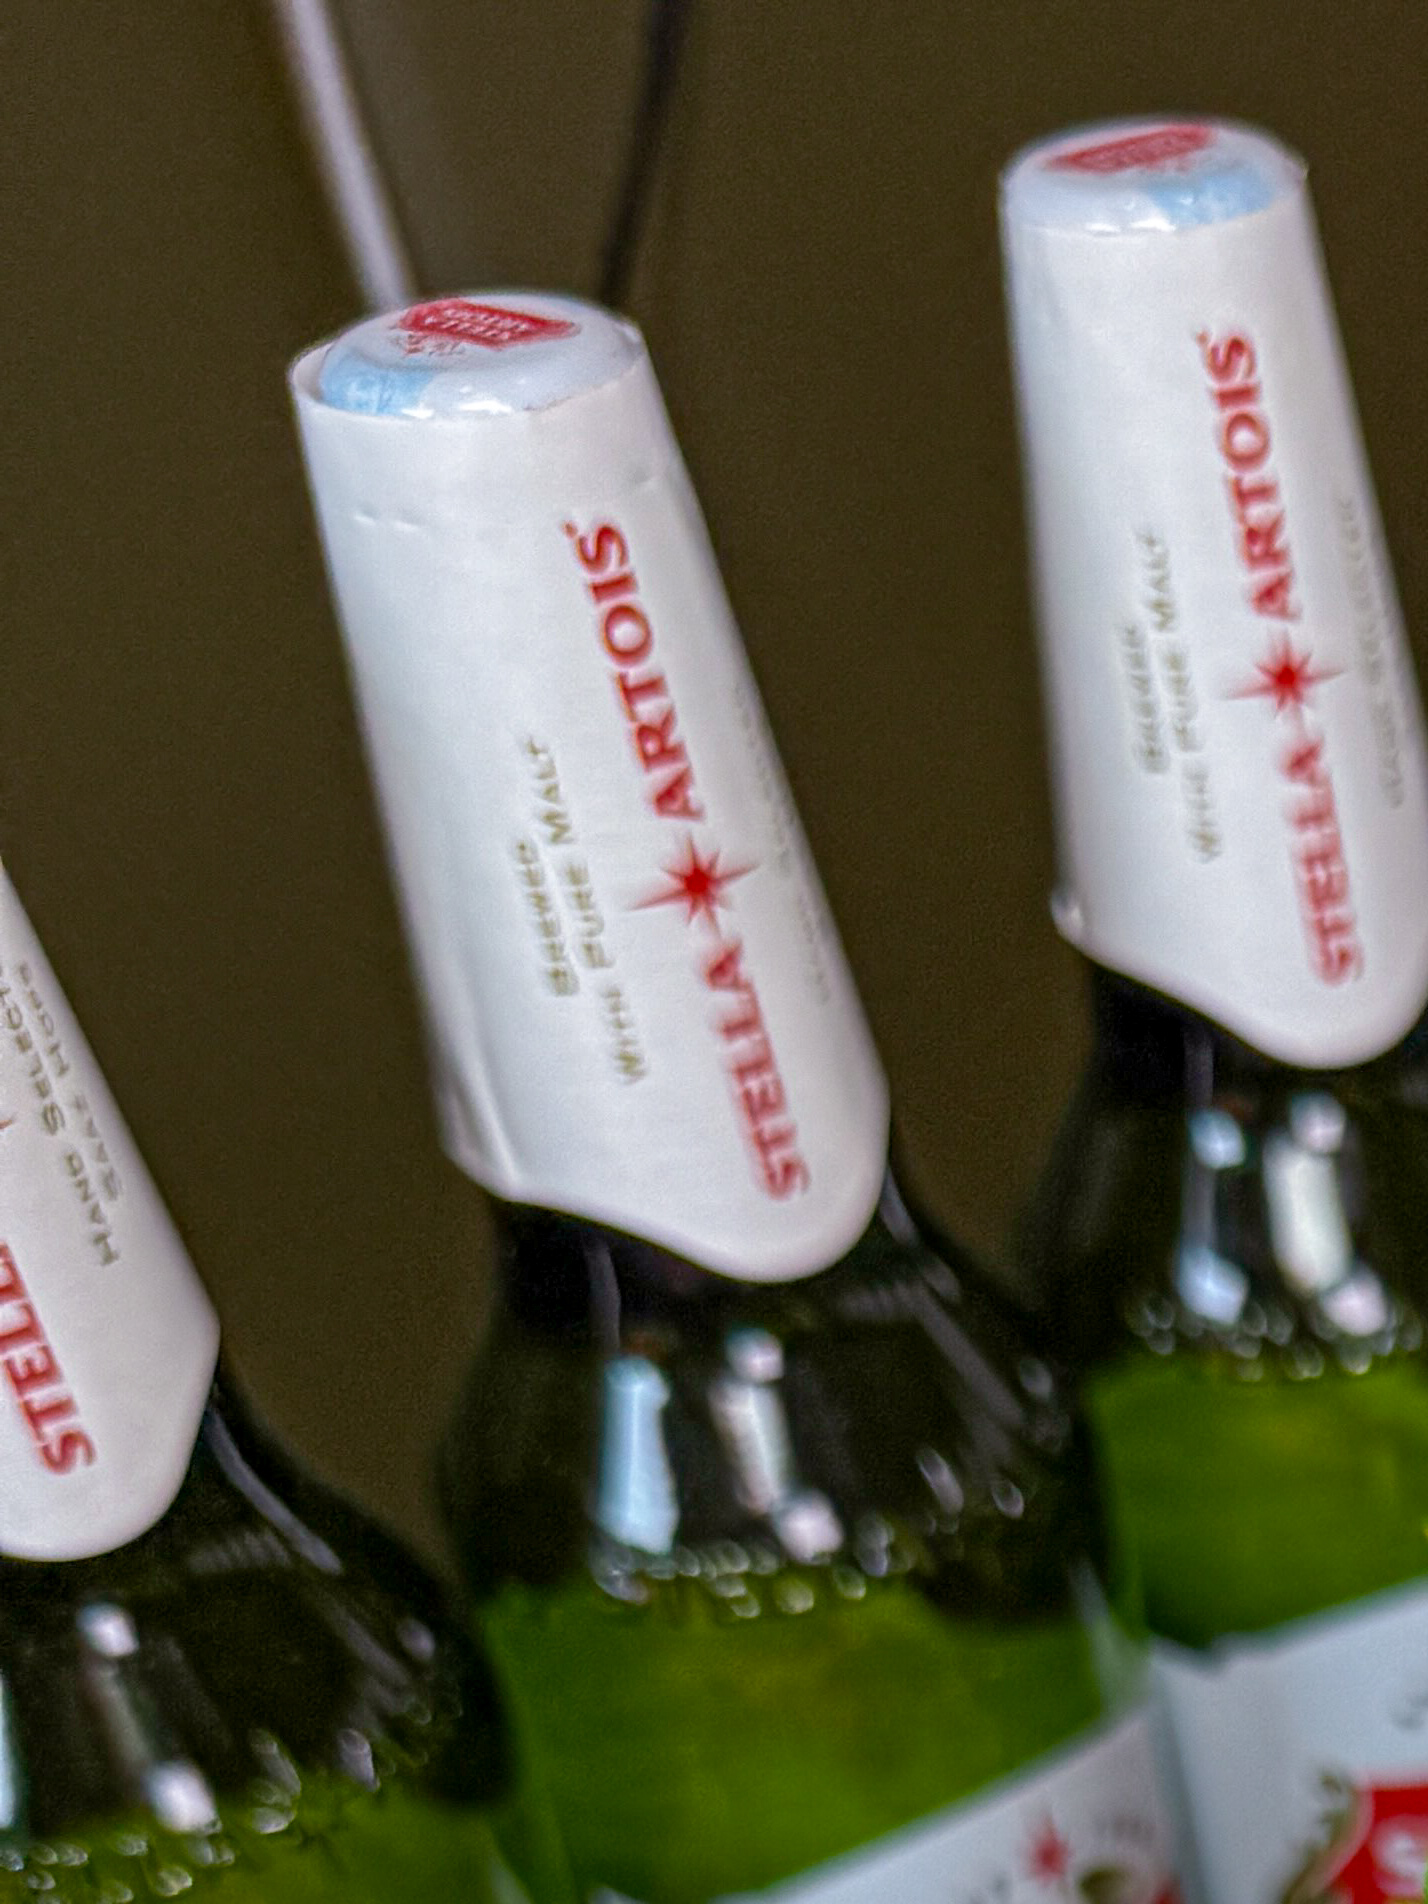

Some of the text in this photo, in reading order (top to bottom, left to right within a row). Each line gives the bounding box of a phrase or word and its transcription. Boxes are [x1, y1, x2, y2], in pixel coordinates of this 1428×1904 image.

[566, 518, 706, 823] ARTOIS
[1198, 326, 1365, 989] STELLA ARTOIS
[700, 938, 811, 1201] STELLA
[0, 1238, 98, 1476] STELL
